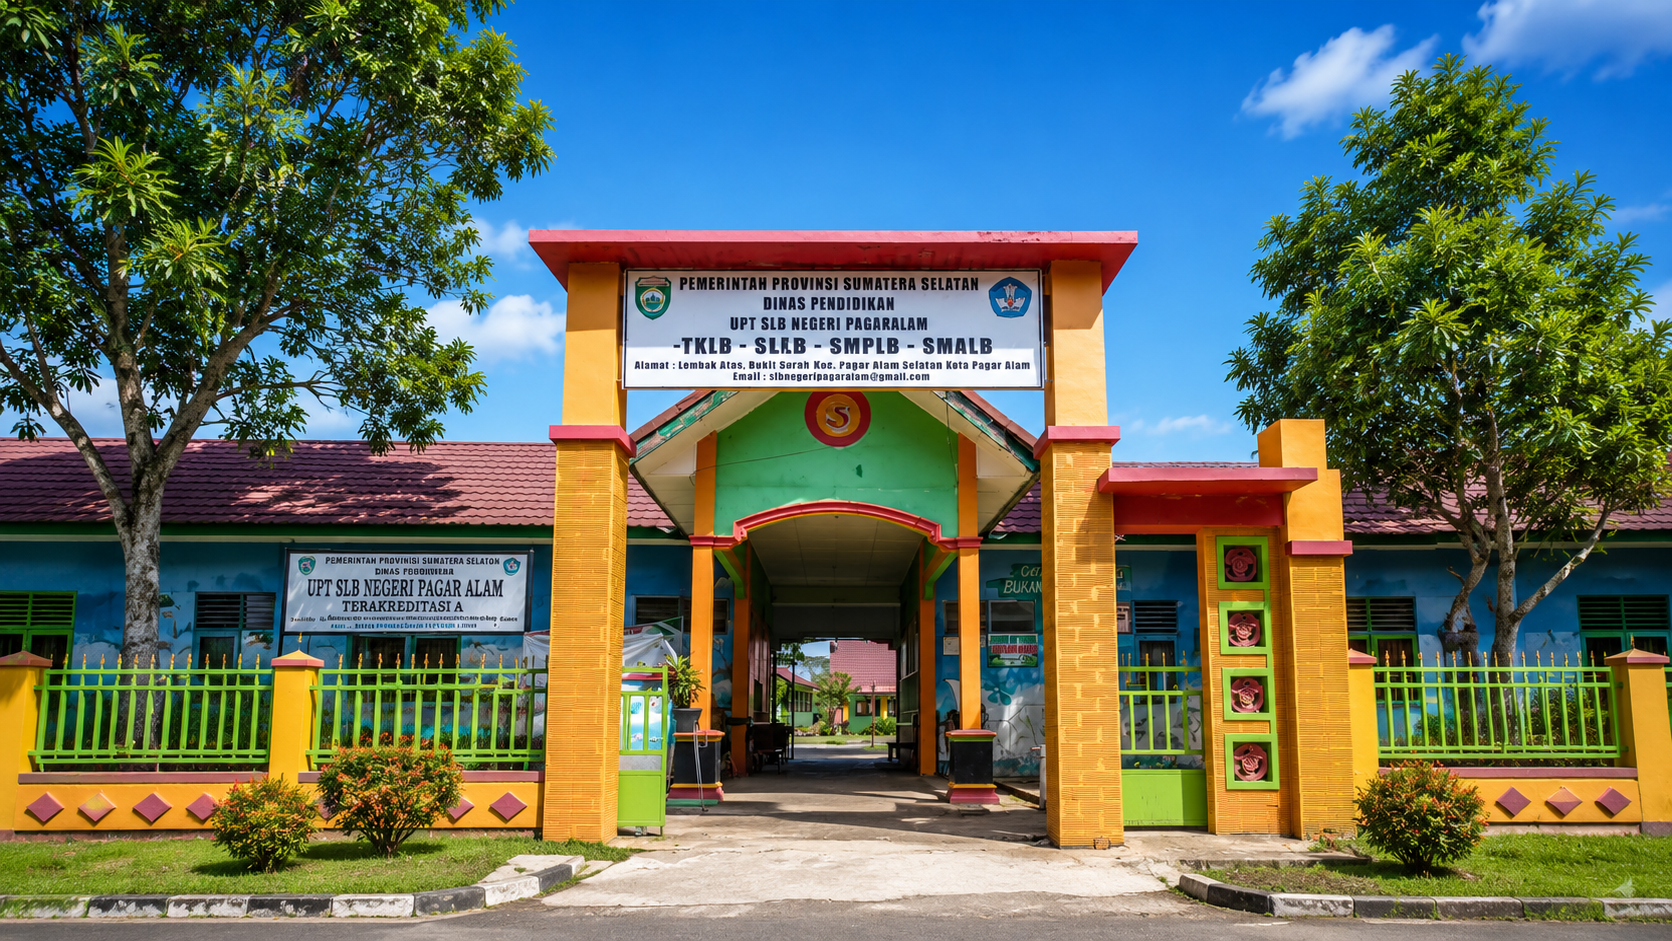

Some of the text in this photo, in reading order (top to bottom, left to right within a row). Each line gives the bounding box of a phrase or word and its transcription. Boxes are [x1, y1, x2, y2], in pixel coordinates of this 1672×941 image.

[679, 276, 979, 291] PEMERINTAH PROVINSI SUMATERA SELATAN
[763, 296, 895, 311] DINAS PENDIDIKAN
[730, 316, 928, 331] UPT SLB NEGERI PAGARALAM
[829, 336, 900, 355] SMPLB
[922, 336, 993, 355] SMALB
[634, 360, 669, 370] Alamat
[678, 360, 717, 370] Lembak
[719, 360, 746, 371] Atas,
[748, 360, 776, 370] Bukit
[839, 360, 870, 372] Pagar
[872, 360, 900, 370] Alam
[902, 360, 943, 370] Selatan
[972, 360, 1002, 372] Pagar
[1004, 360, 1031, 370] Alam
[732, 371, 761, 381] Email
[307, 578, 504, 598] UPT SLB NEGERI PAGAR ALAM
[342, 600, 464, 613] TERAKREDITASI A
